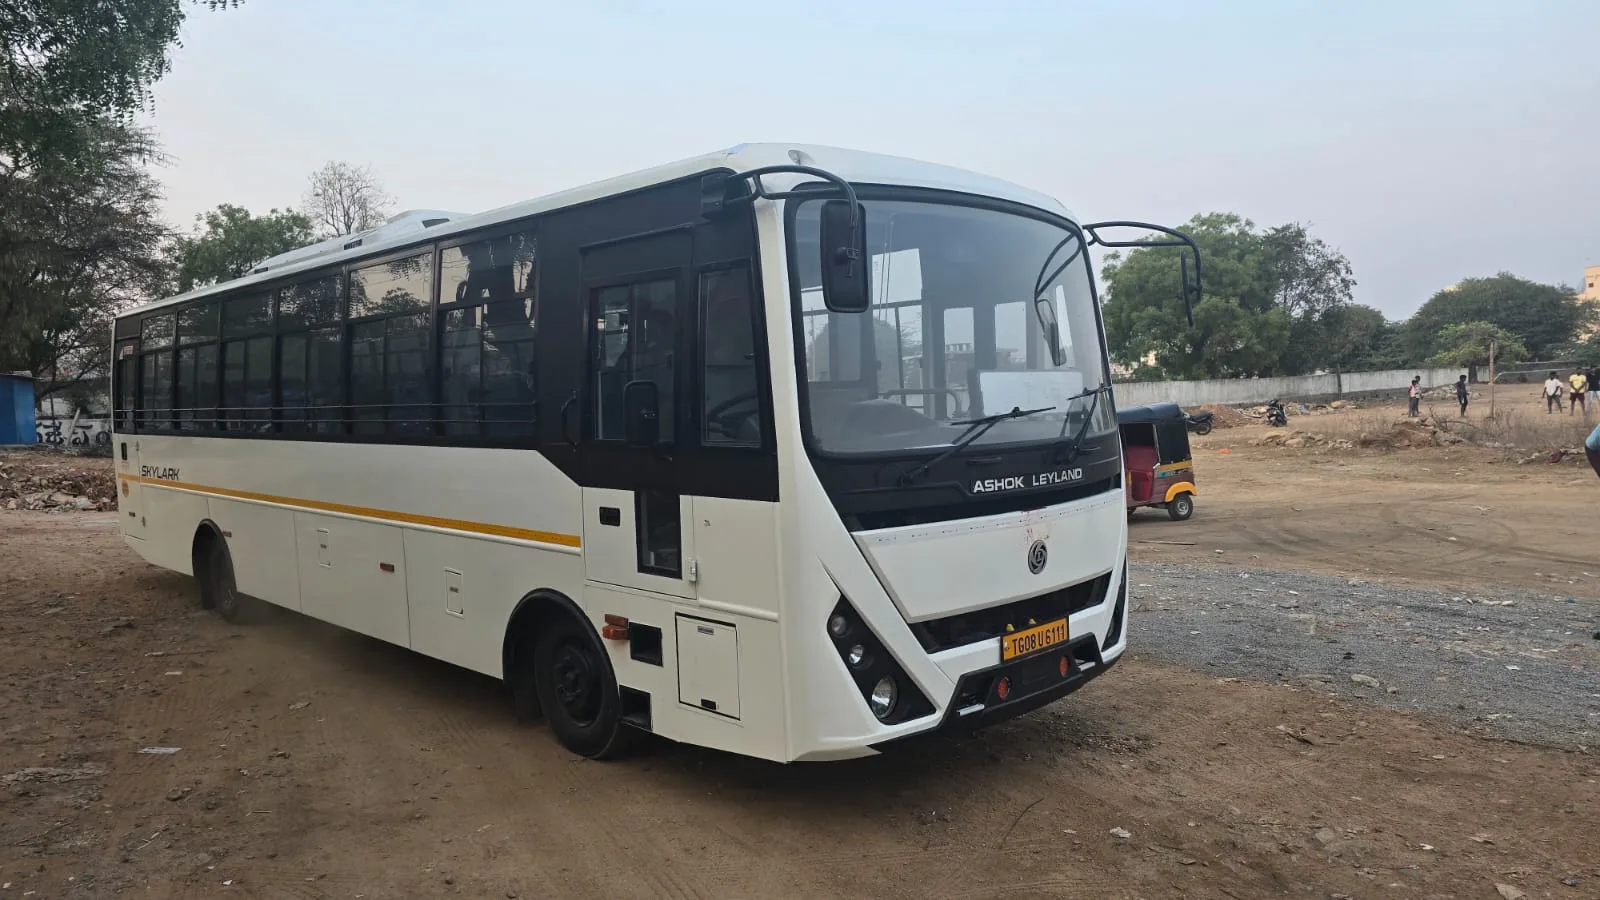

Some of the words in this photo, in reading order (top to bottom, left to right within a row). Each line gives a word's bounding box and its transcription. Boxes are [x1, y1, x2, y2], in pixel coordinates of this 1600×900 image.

[141, 465, 180, 480] SKYLARK
[973, 476, 1025, 493] ASHOK
[1032, 468, 1082, 486] LEYLAND
